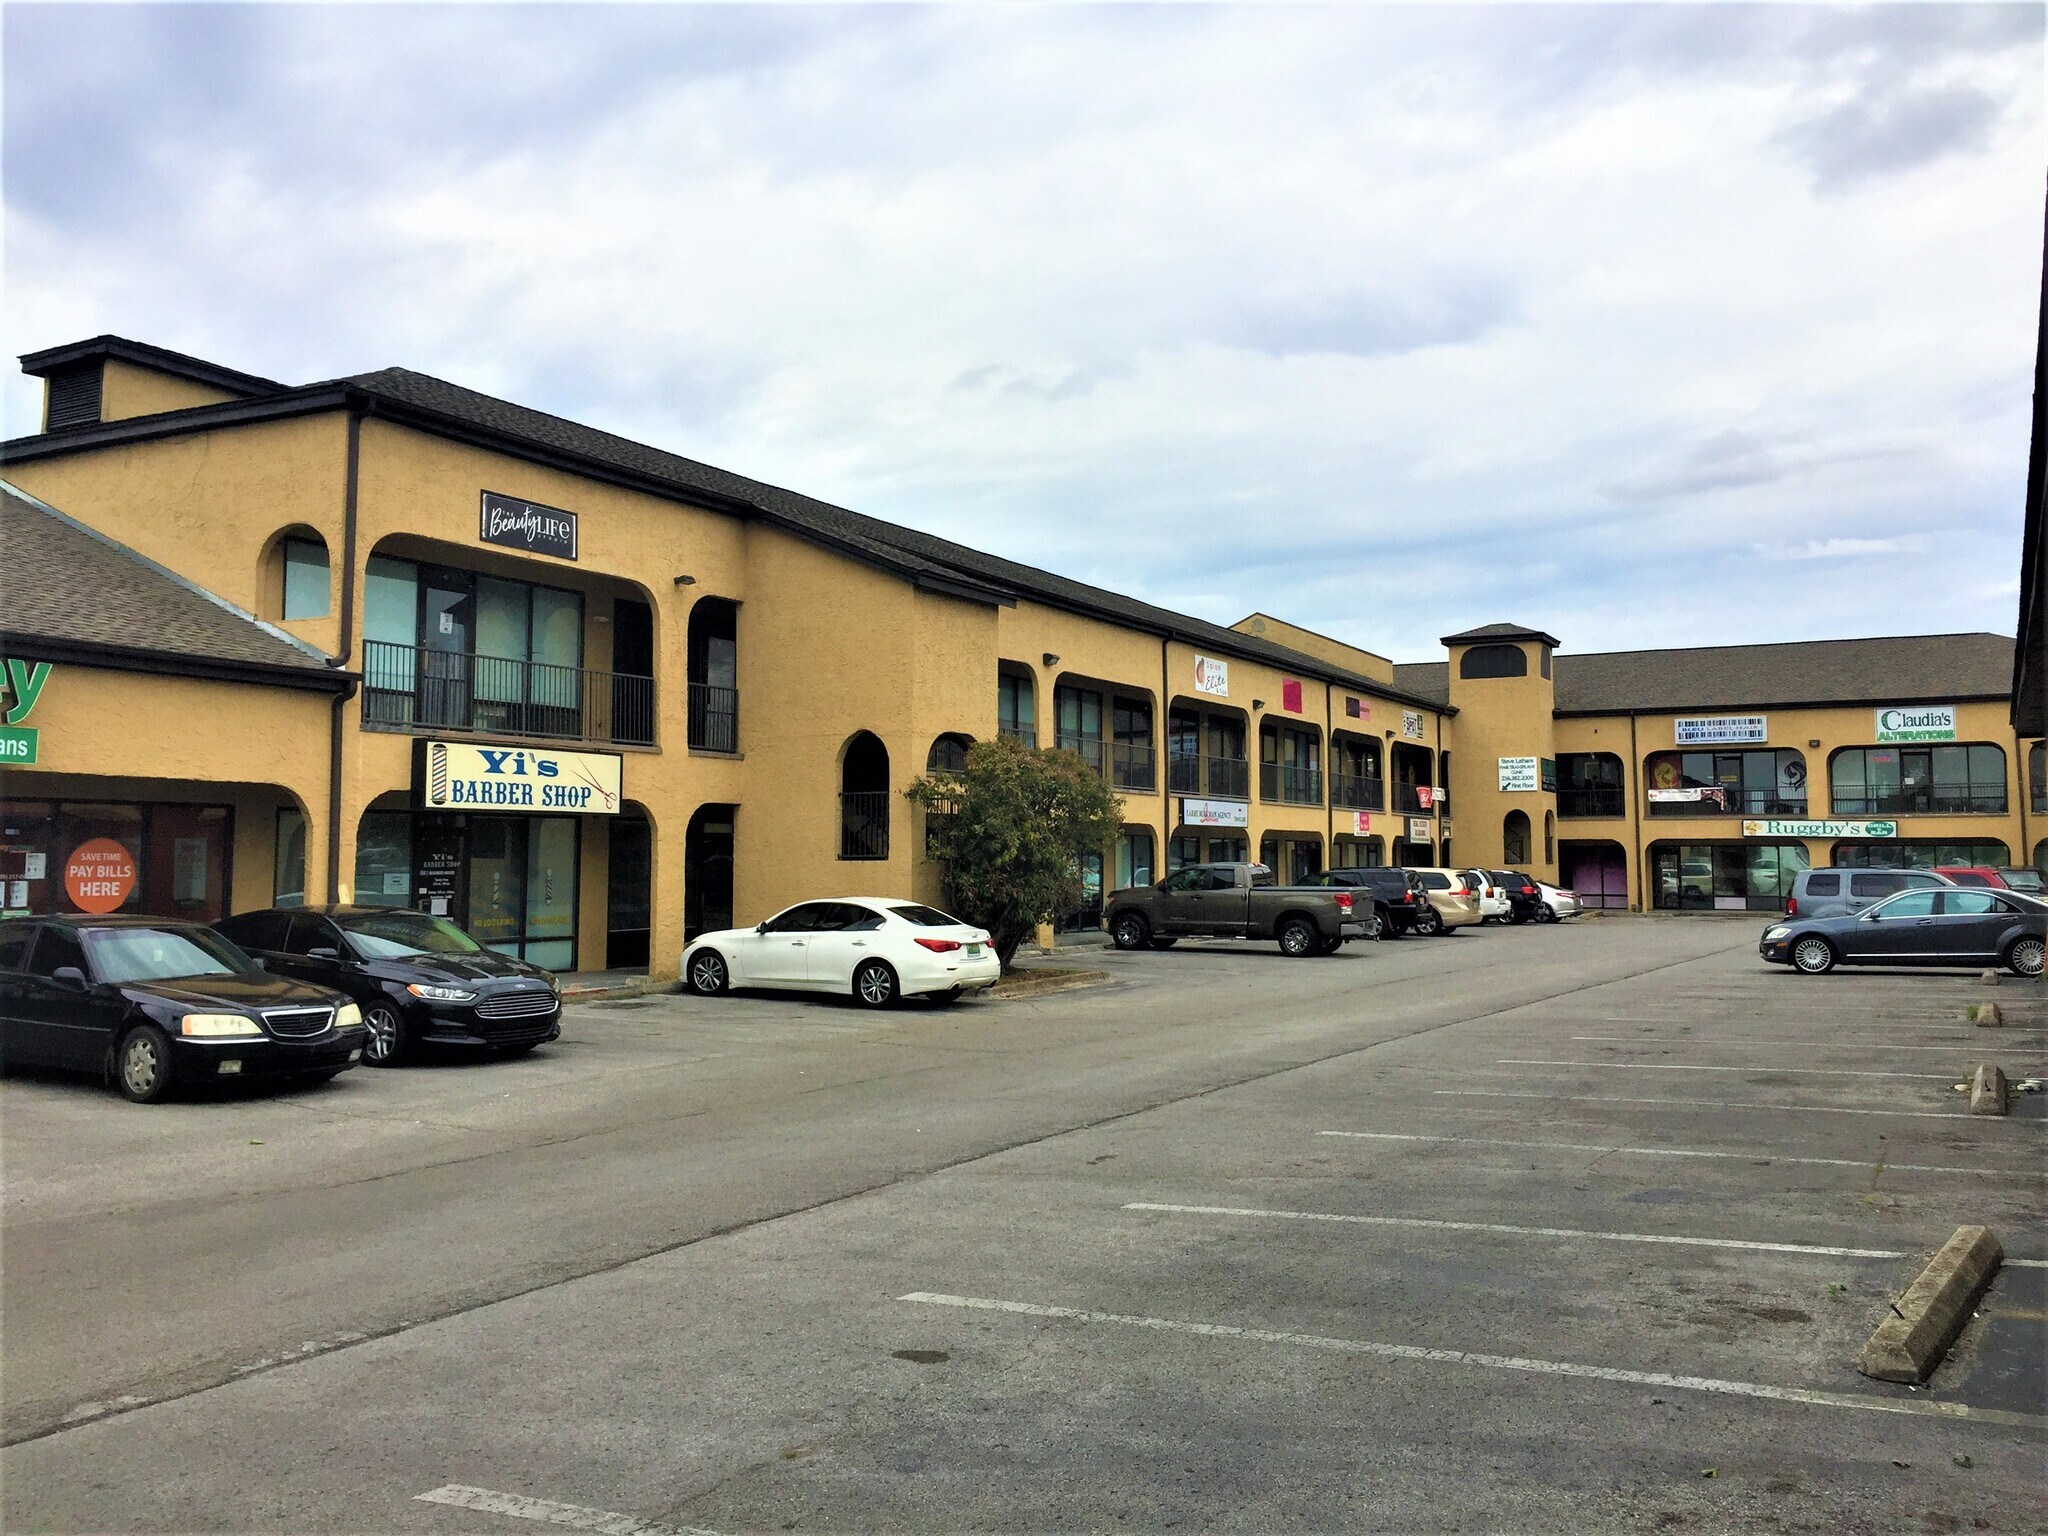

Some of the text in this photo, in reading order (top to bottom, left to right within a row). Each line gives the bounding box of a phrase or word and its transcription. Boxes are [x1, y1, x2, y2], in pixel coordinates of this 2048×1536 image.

[489, 506, 536, 542] Beauty
[1205, 675, 1226, 691] Elite
[1881, 710, 1951, 731] Claudia's
[1878, 729, 1954, 741] ALTERATIONS
[476, 749, 559, 778] Yi's
[451, 779, 592, 808] BARBER SHOP
[1766, 821, 1861, 836] Ruggby's
[80, 852, 122, 861] SAVE TIME
[69, 865, 132, 878] PAY BILLS
[79, 881, 120, 897] HERE
